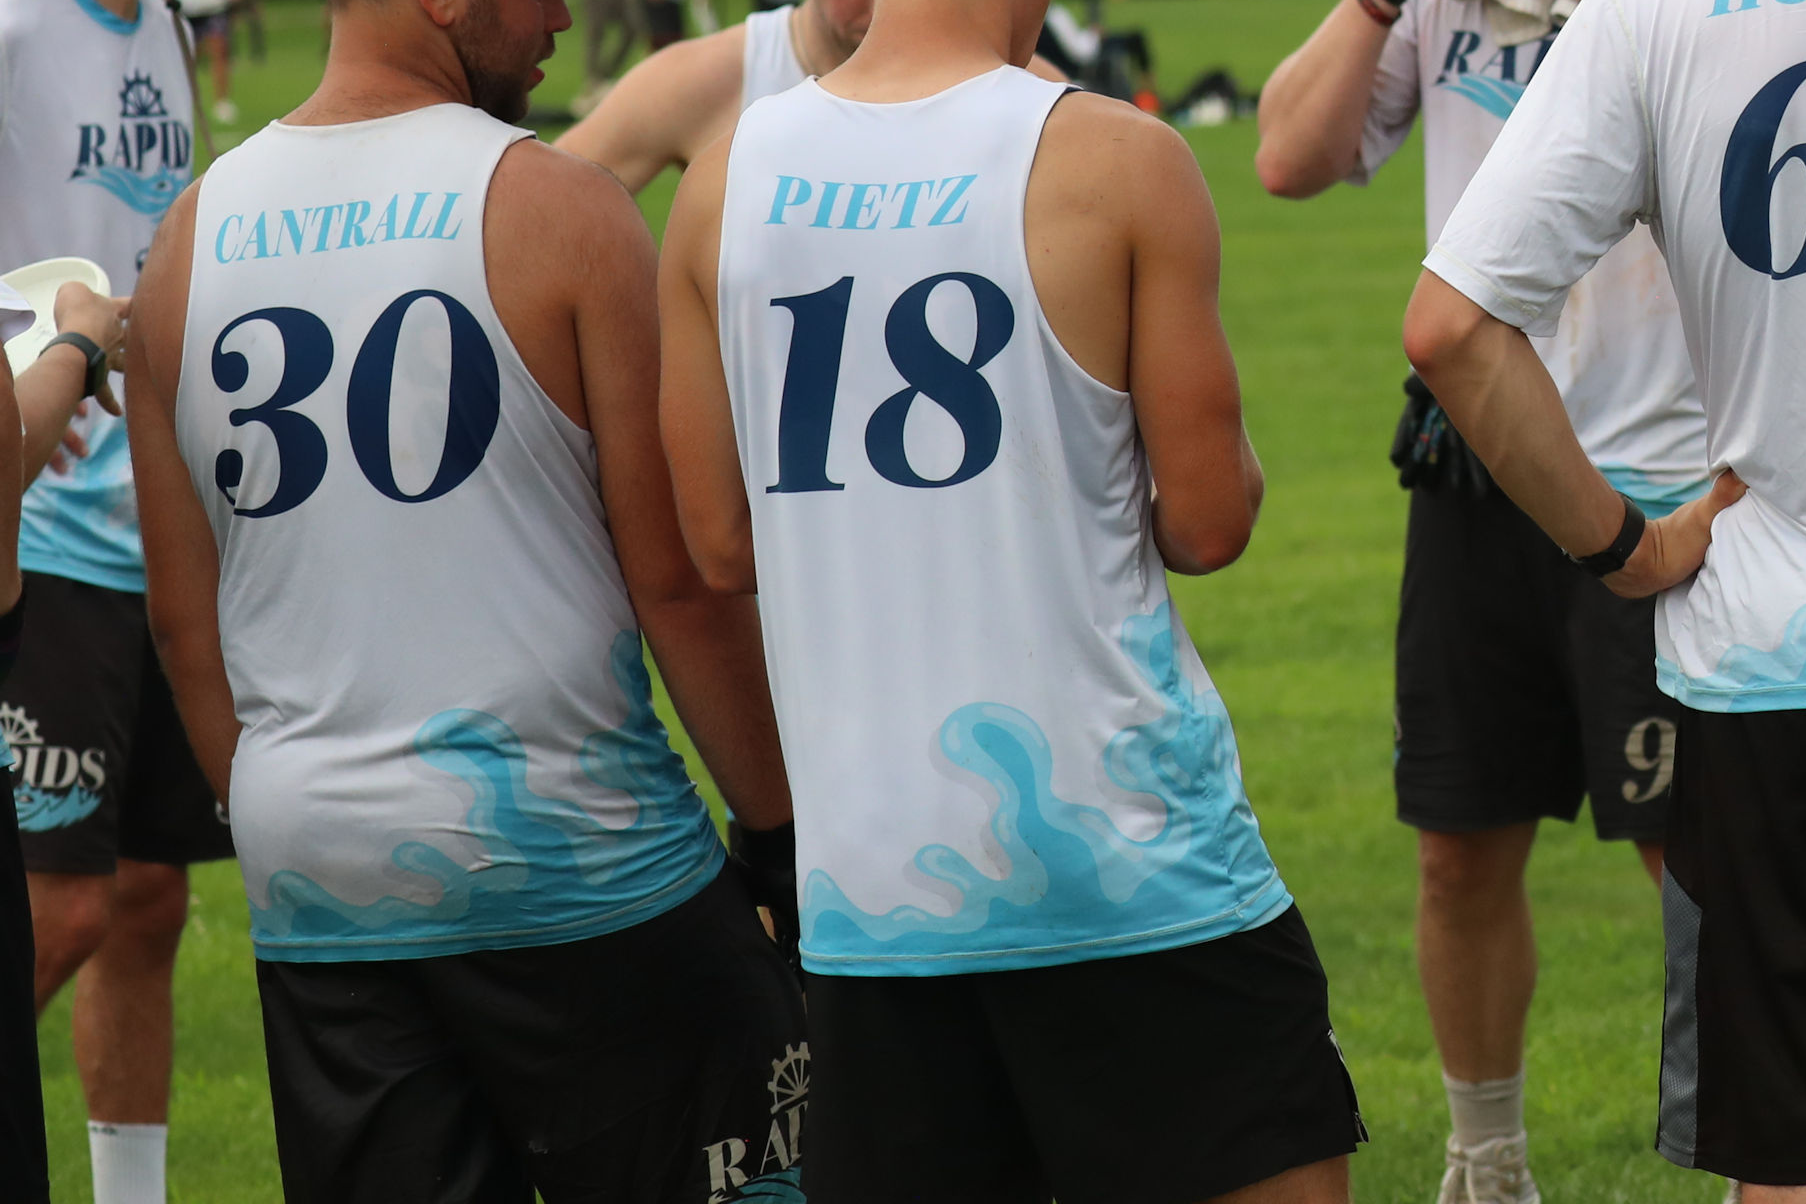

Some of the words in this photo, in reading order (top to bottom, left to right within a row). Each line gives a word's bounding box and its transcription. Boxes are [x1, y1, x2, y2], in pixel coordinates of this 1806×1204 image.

[215, 192, 463, 264] CANTRALL
[764, 173, 978, 230] PIETZ
[211, 288, 500, 518] 30
[765, 271, 1015, 494] 18
